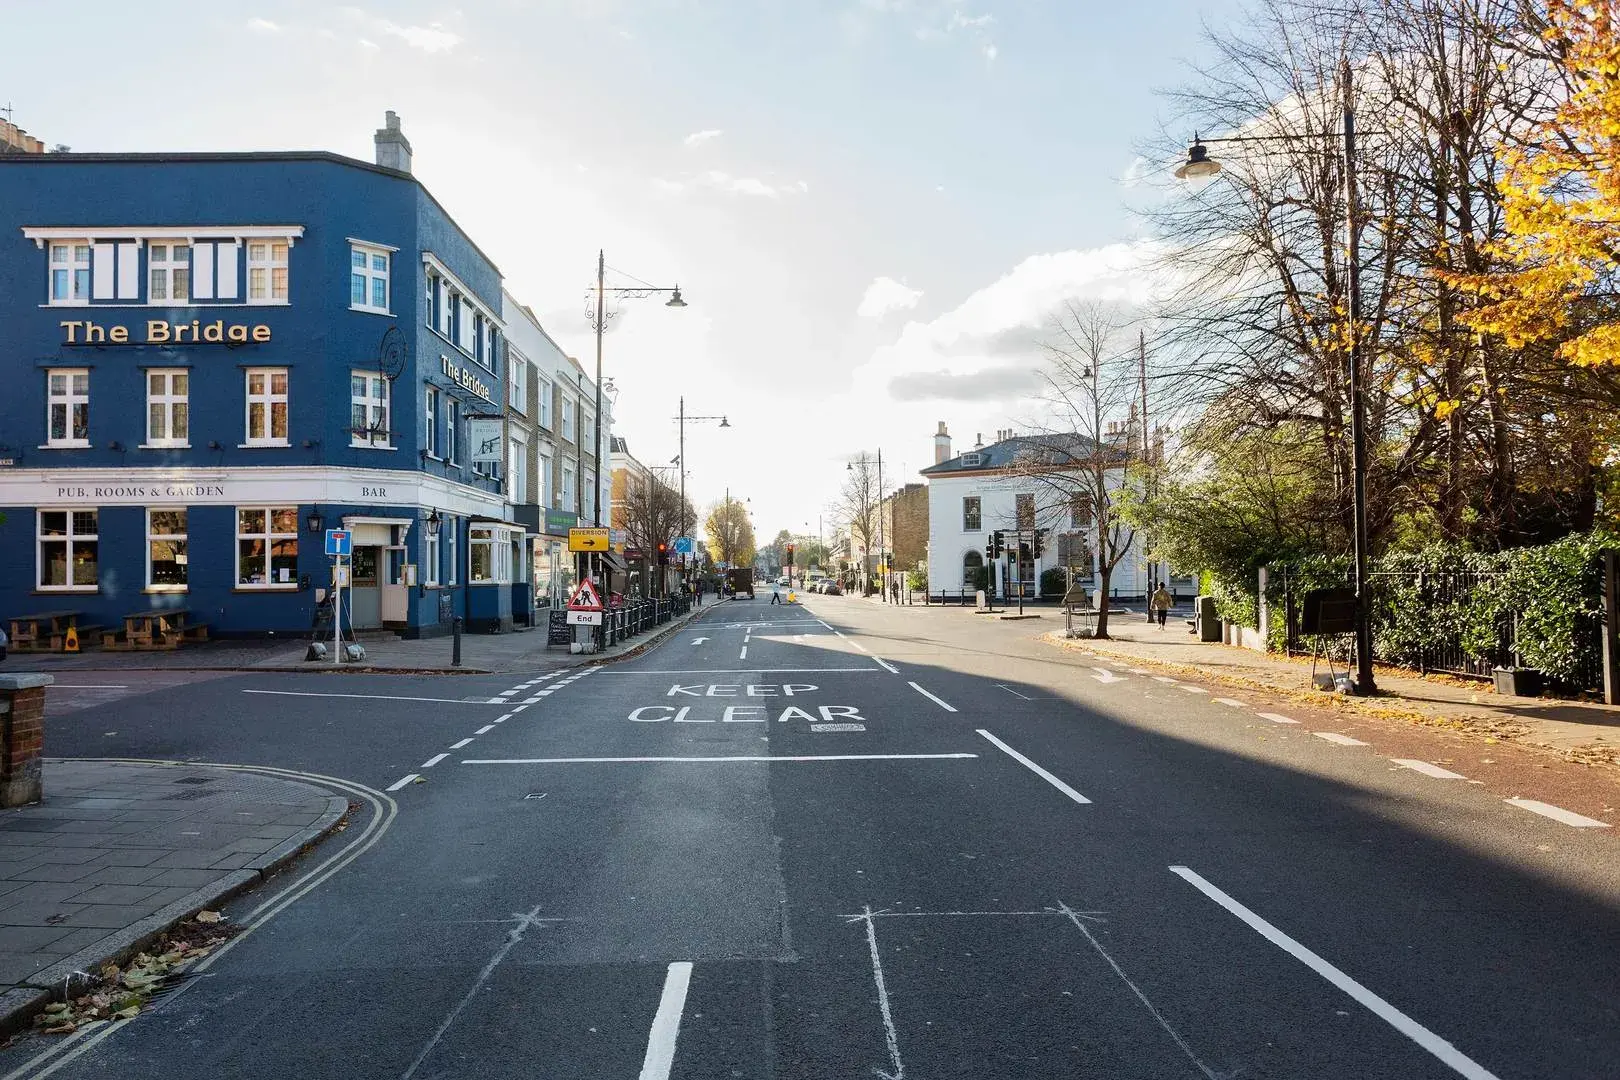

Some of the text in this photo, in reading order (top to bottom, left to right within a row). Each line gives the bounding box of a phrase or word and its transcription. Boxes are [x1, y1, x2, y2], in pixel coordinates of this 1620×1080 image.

[60, 320, 271, 345] The Bridge
[441, 354, 490, 400] The Bridge
[58, 486, 224, 498] PUB, ROOMS & GARDEN
[362, 487, 387, 497] BAR
[666, 684, 819, 697] KEEP
[627, 705, 867, 723] CLEAR
